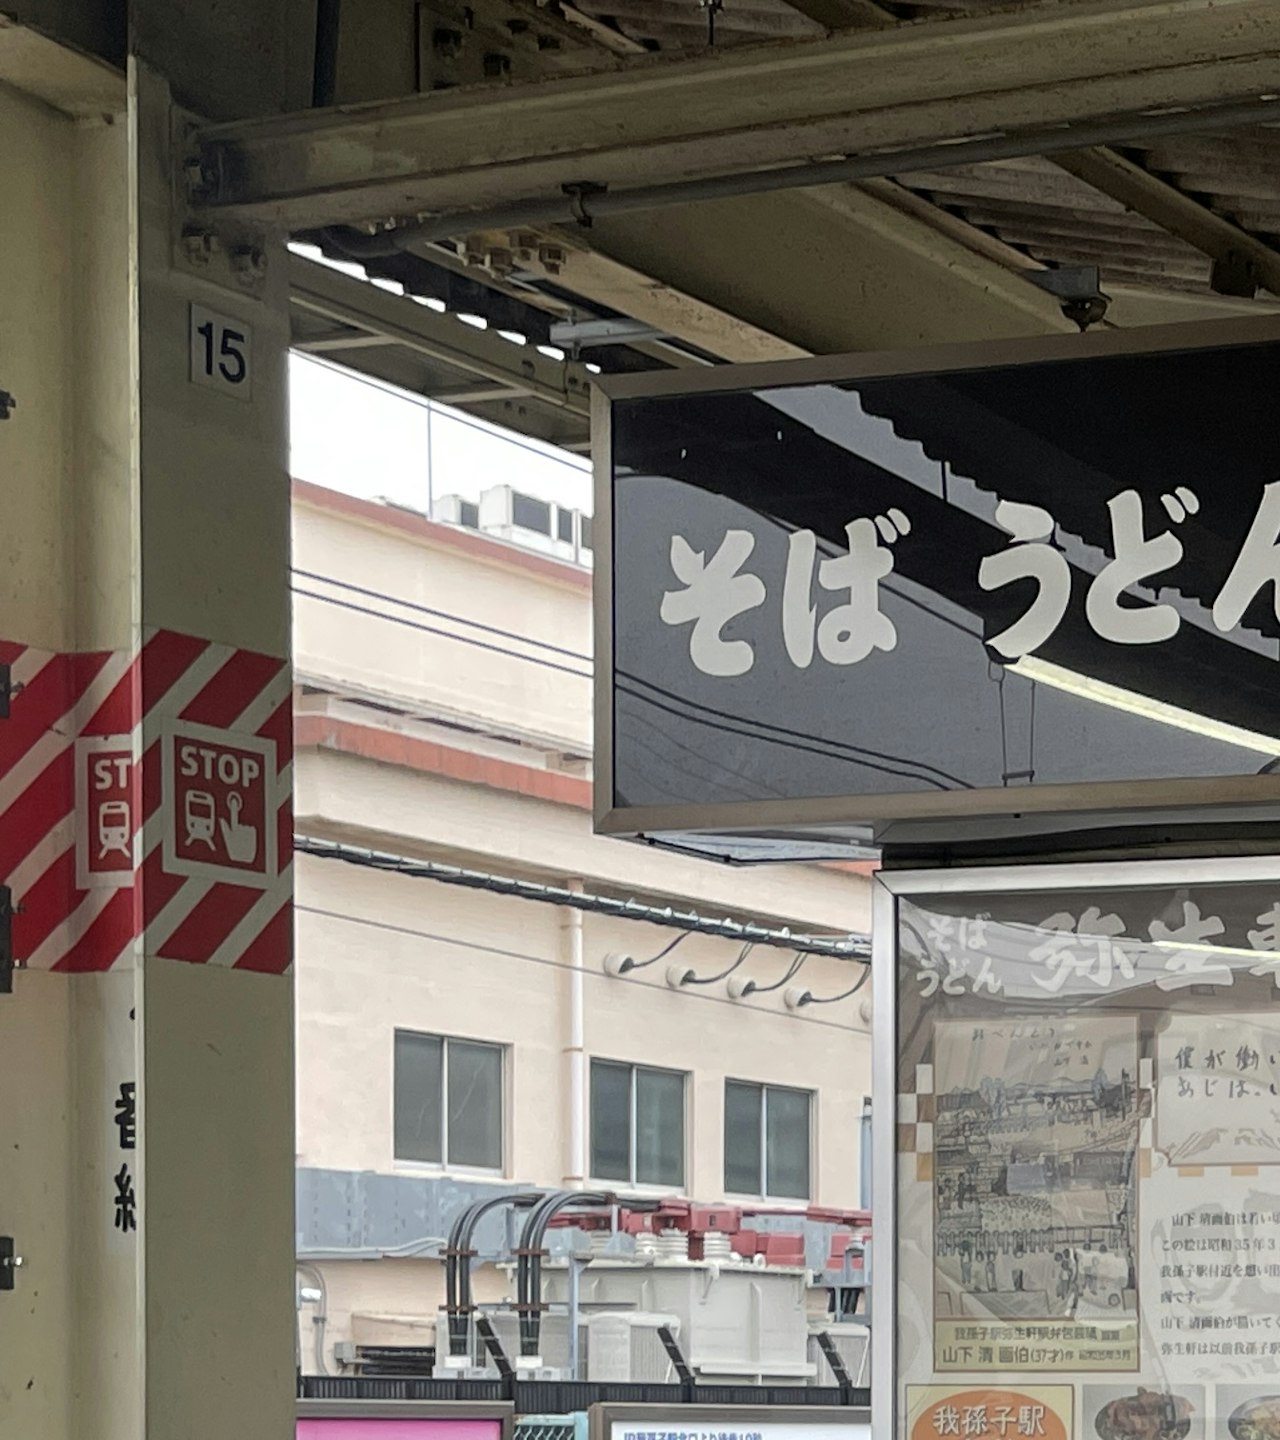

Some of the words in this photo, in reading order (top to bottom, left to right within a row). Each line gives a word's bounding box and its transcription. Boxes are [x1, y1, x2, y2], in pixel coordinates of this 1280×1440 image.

[197, 322, 246, 384] 15
[660, 506, 911, 677] そば
[180, 745, 260, 789] STOP
[927, 911, 992, 952] そば
[916, 957, 1002, 998] うどん
[932, 1404, 1046, 1436] 我孫子駅
